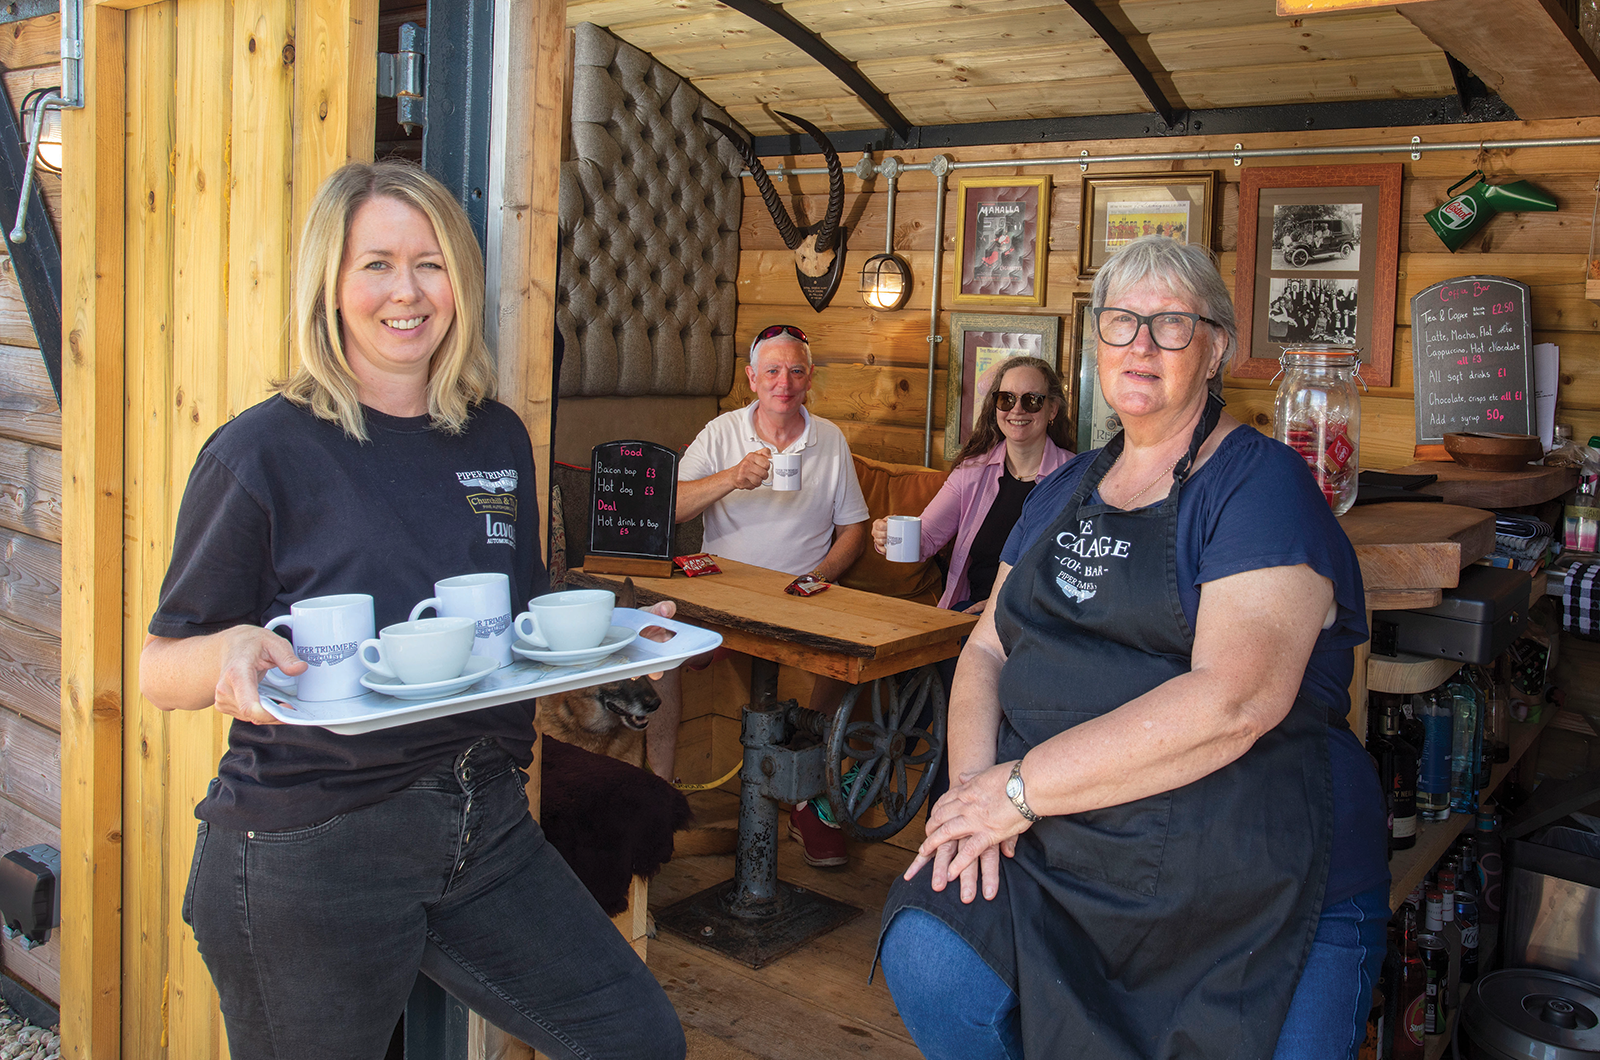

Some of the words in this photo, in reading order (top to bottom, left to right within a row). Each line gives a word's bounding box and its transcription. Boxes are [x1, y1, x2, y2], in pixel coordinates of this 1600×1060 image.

[978, 205, 1020, 217] MAHALLA
[1445, 201, 1473, 220] Castrol
[1473, 282, 1490, 297] Bar
[1421, 309, 1437, 324] Tea
[1440, 309, 1445, 321] &
[1426, 330, 1449, 343] Latte,
[1451, 329, 1478, 341] Mocha,
[1480, 325, 1492, 337] Flat
[1470, 342, 1485, 354] Hot
[1457, 356, 1469, 365] all
[1473, 354, 1482, 363] £3
[1429, 370, 1441, 383] All
[1447, 371, 1463, 384] soft
[1469, 370, 1491, 380] drinks
[1498, 368, 1507, 378] £1
[1468, 395, 1486, 404] crisps
[1489, 393, 1499, 401] etc
[1500, 391, 1512, 401] all
[1515, 391, 1522, 401] £1
[1430, 413, 1446, 425] Add
[1461, 415, 1480, 426] syrup
[1486, 408, 1504, 422] 50p
[620, 446, 643, 457] Food
[456, 470, 484, 480] PIPER
[597, 461, 621, 474] Bacon
[625, 467, 637, 477] bap
[646, 467, 656, 479] £3
[598, 478, 614, 492] Hot
[619, 482, 634, 496] dog
[644, 486, 655, 496] £3
[597, 499, 617, 511] Deal
[597, 515, 613, 527] Hot
[617, 516, 636, 527] drink
[1057, 570, 1078, 586] PIPER
[314, 641, 358, 653] TRIMMERS
[307, 653, 343, 662] SPECIALIST
